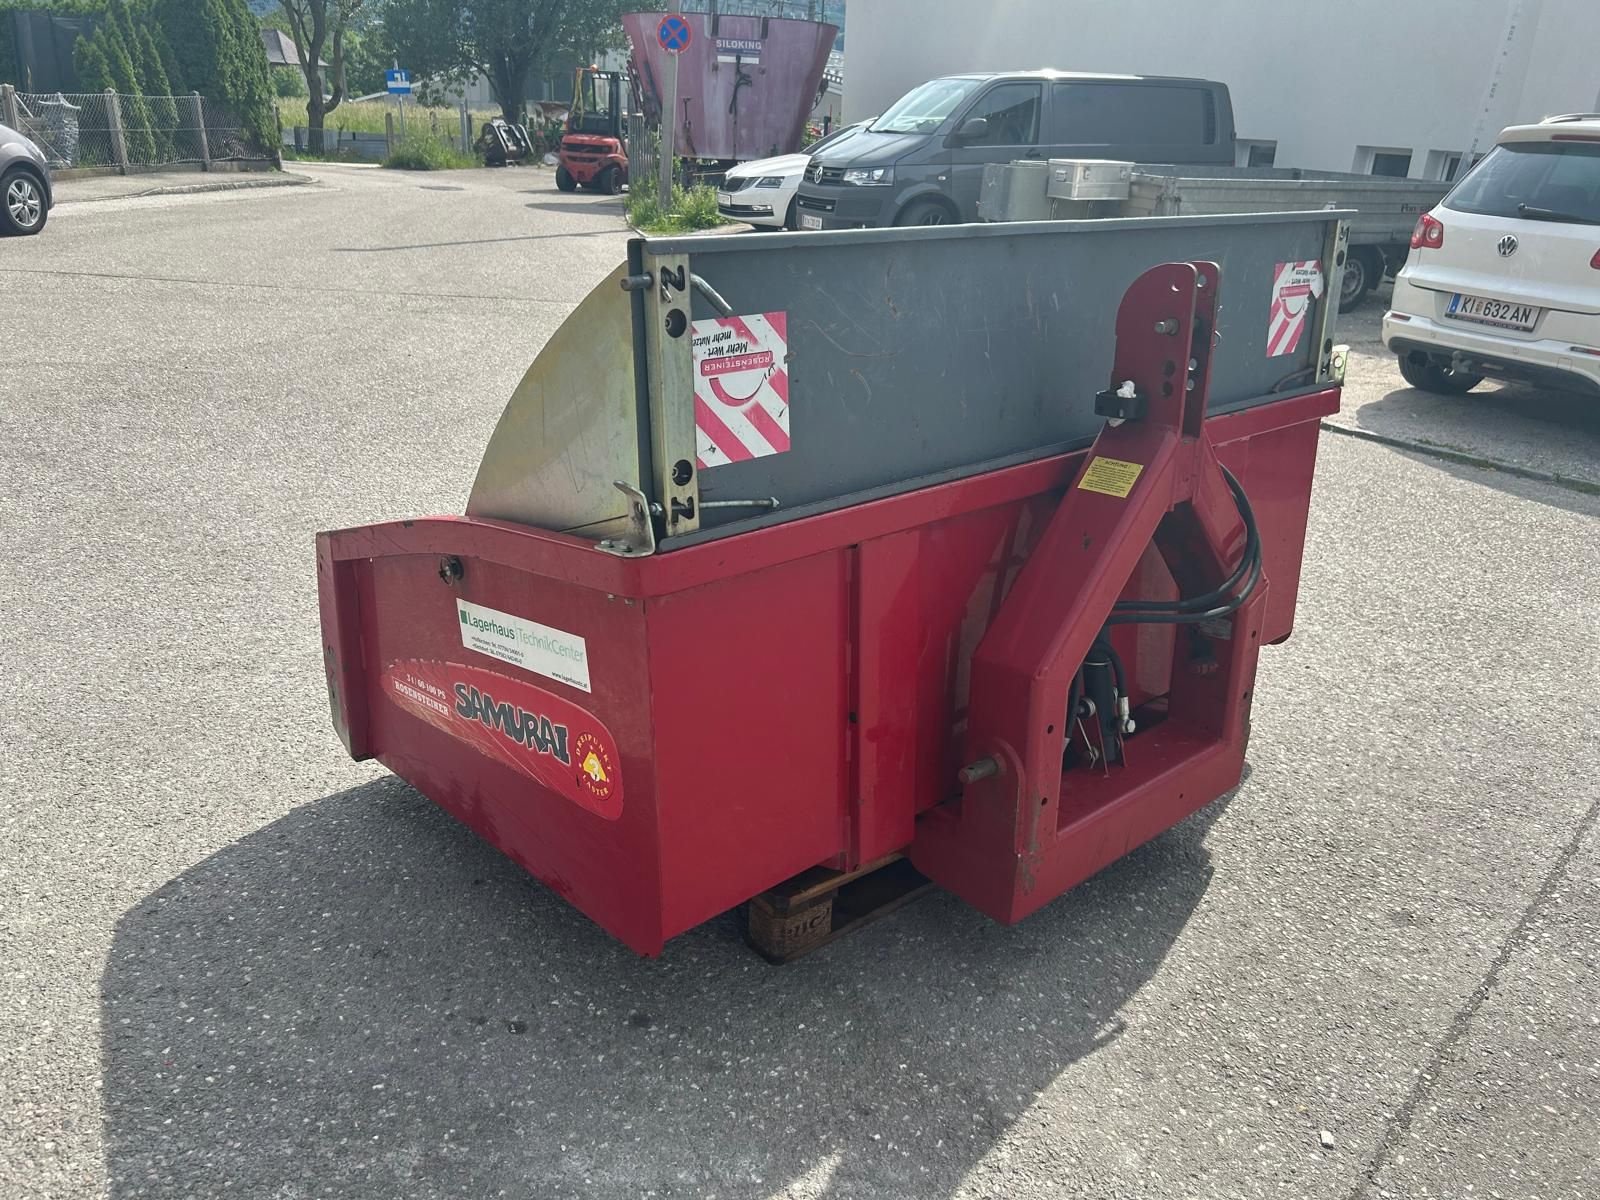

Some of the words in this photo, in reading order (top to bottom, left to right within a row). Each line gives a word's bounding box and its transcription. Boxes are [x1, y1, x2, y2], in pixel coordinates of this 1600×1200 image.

[716, 39, 761, 50] SILOKING
[1461, 296, 1476, 314] KI
[1483, 301, 1510, 320] 632
[1510, 306, 1532, 323] AN
[692, 335, 712, 347] Nutze
[710, 329, 732, 345] mehr
[708, 346, 725, 358] Wert
[725, 341, 749, 356] Mehr
[703, 355, 771, 372] ROSENSTEINER
[467, 611, 516, 640] Lagerhaus
[518, 626, 585, 663] TechnikCenter
[394, 680, 450, 717] ROSENSTEINER
[437, 688, 446, 700] PS
[454, 682, 571, 767] SAMURAI
